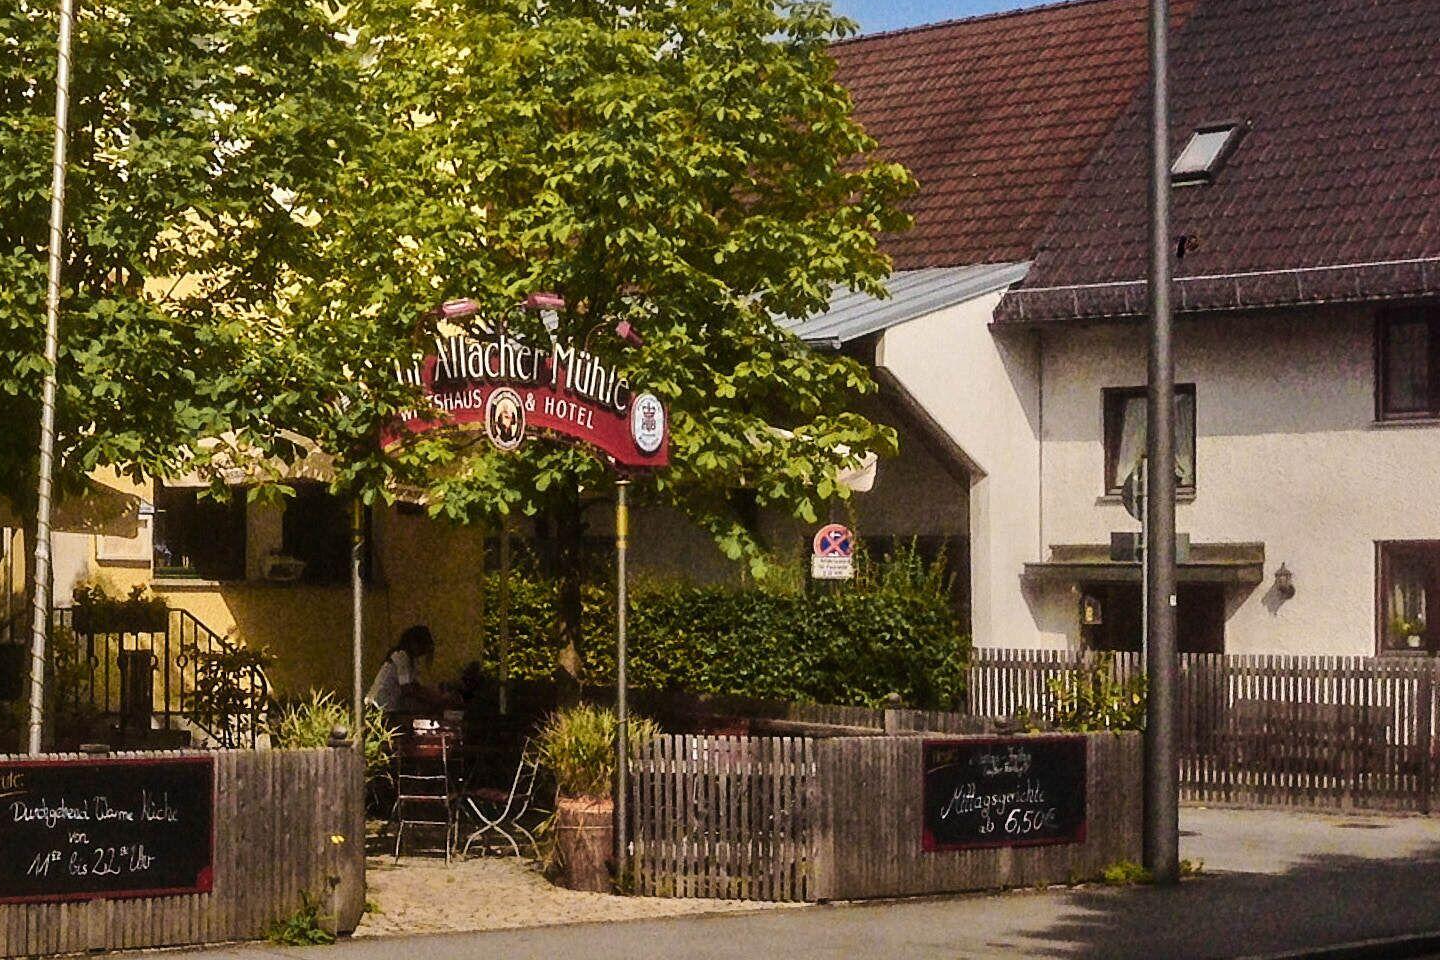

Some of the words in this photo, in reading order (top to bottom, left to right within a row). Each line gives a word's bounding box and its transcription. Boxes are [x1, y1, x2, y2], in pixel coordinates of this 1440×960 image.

[434, 335, 546, 381] Allacher
[551, 342, 629, 410] Mühle
[524, 392, 536, 412] &
[545, 396, 594, 430] HOTEL
[69, 832, 90, 844] von
